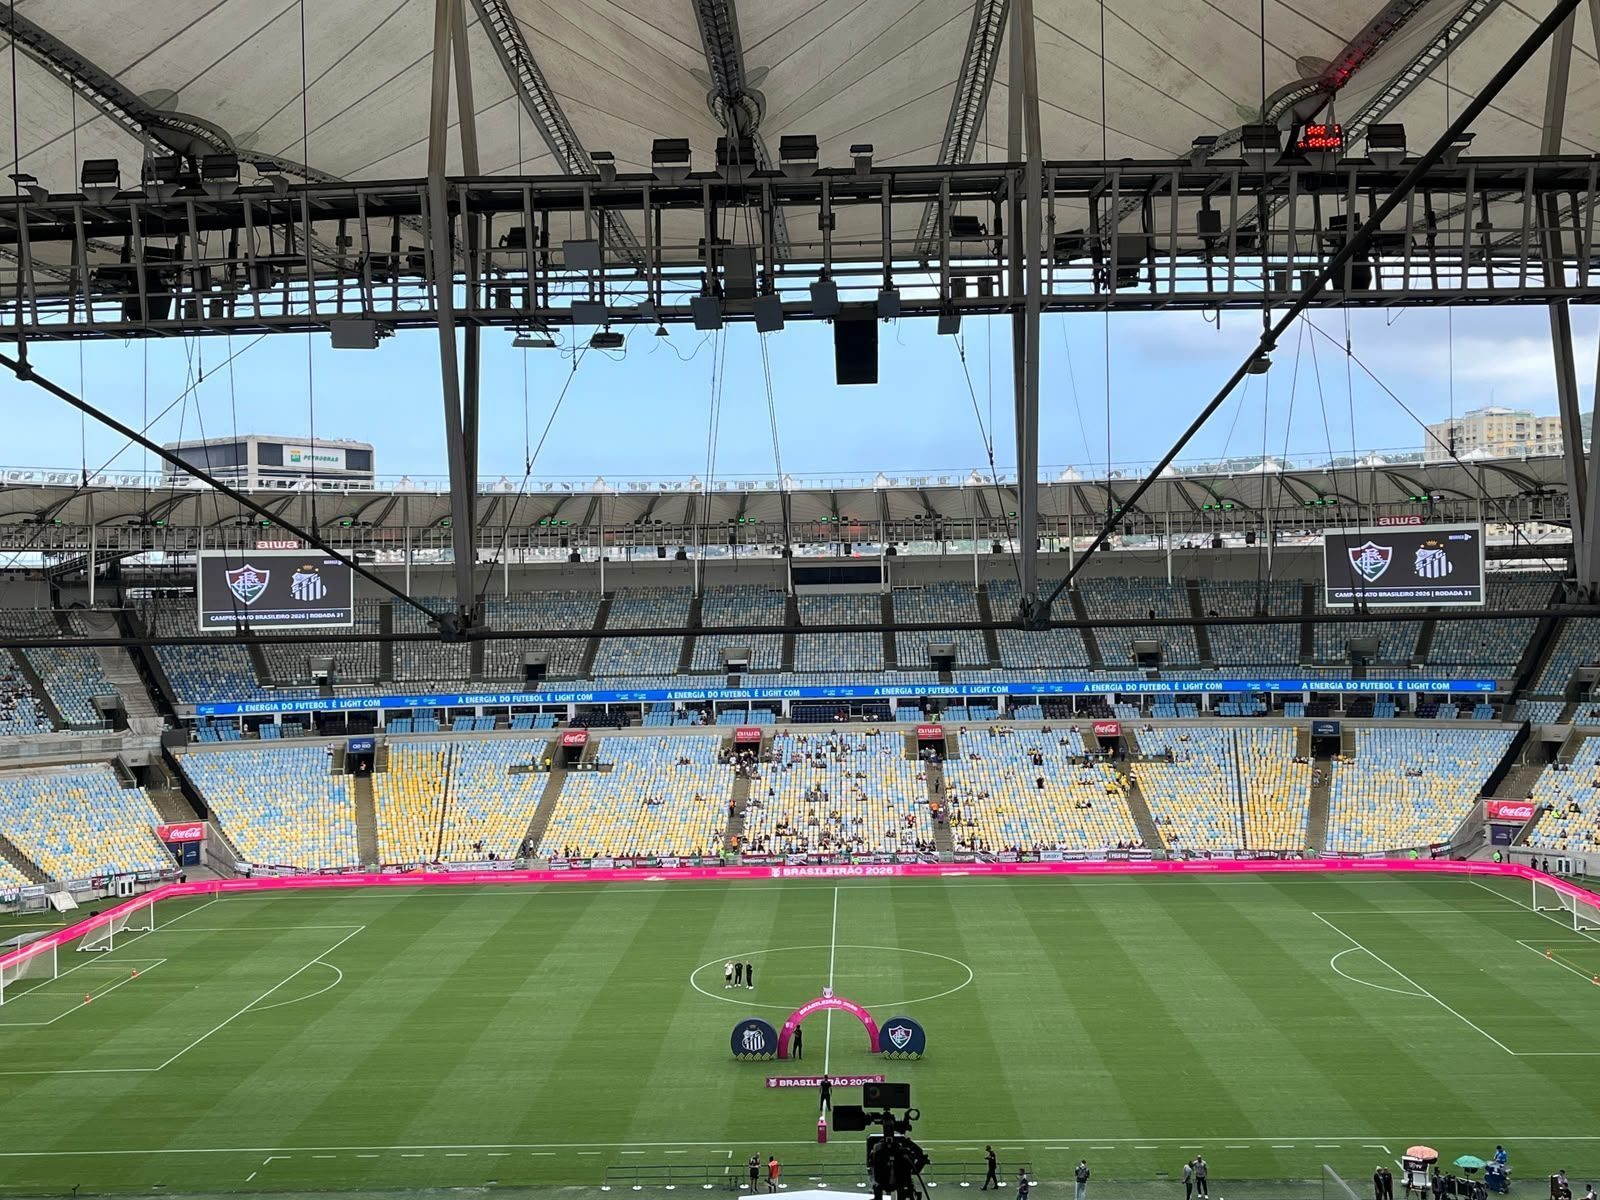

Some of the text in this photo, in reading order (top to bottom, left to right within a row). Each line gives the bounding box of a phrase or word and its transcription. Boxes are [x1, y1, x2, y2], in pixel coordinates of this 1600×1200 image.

[1379, 516, 1421, 525] aiwa
[257, 540, 298, 549] aiwa
[881, 686, 913, 694] ENERGIA
[928, 686, 959, 694] FUTEBOL
[992, 685, 1009, 693] COM
[1091, 683, 1123, 691] ENERGIA
[1182, 682, 1203, 690] LIGHT
[1407, 682, 1429, 690] LIGHT
[465, 695, 497, 703] ENERGIA
[512, 694, 543, 702] FUTEBOL
[576, 693, 593, 701] COM
[674, 691, 706, 699] ENERGIA
[762, 689, 782, 697] LIGHT
[245, 703, 279, 711] ENERGIA
[281, 702, 293, 710] DO
[295, 701, 328, 709] FUTEBOL
[340, 700, 361, 708] LIGHT
[363, 699, 380, 707] COM
[1499, 805, 1533, 817] Coca-Cola
[170, 827, 202, 840] Coca-Cola
[783, 866, 893, 876] BRASILEIRÃO 2026
[779, 1077, 849, 1087] BRASILERÃO
